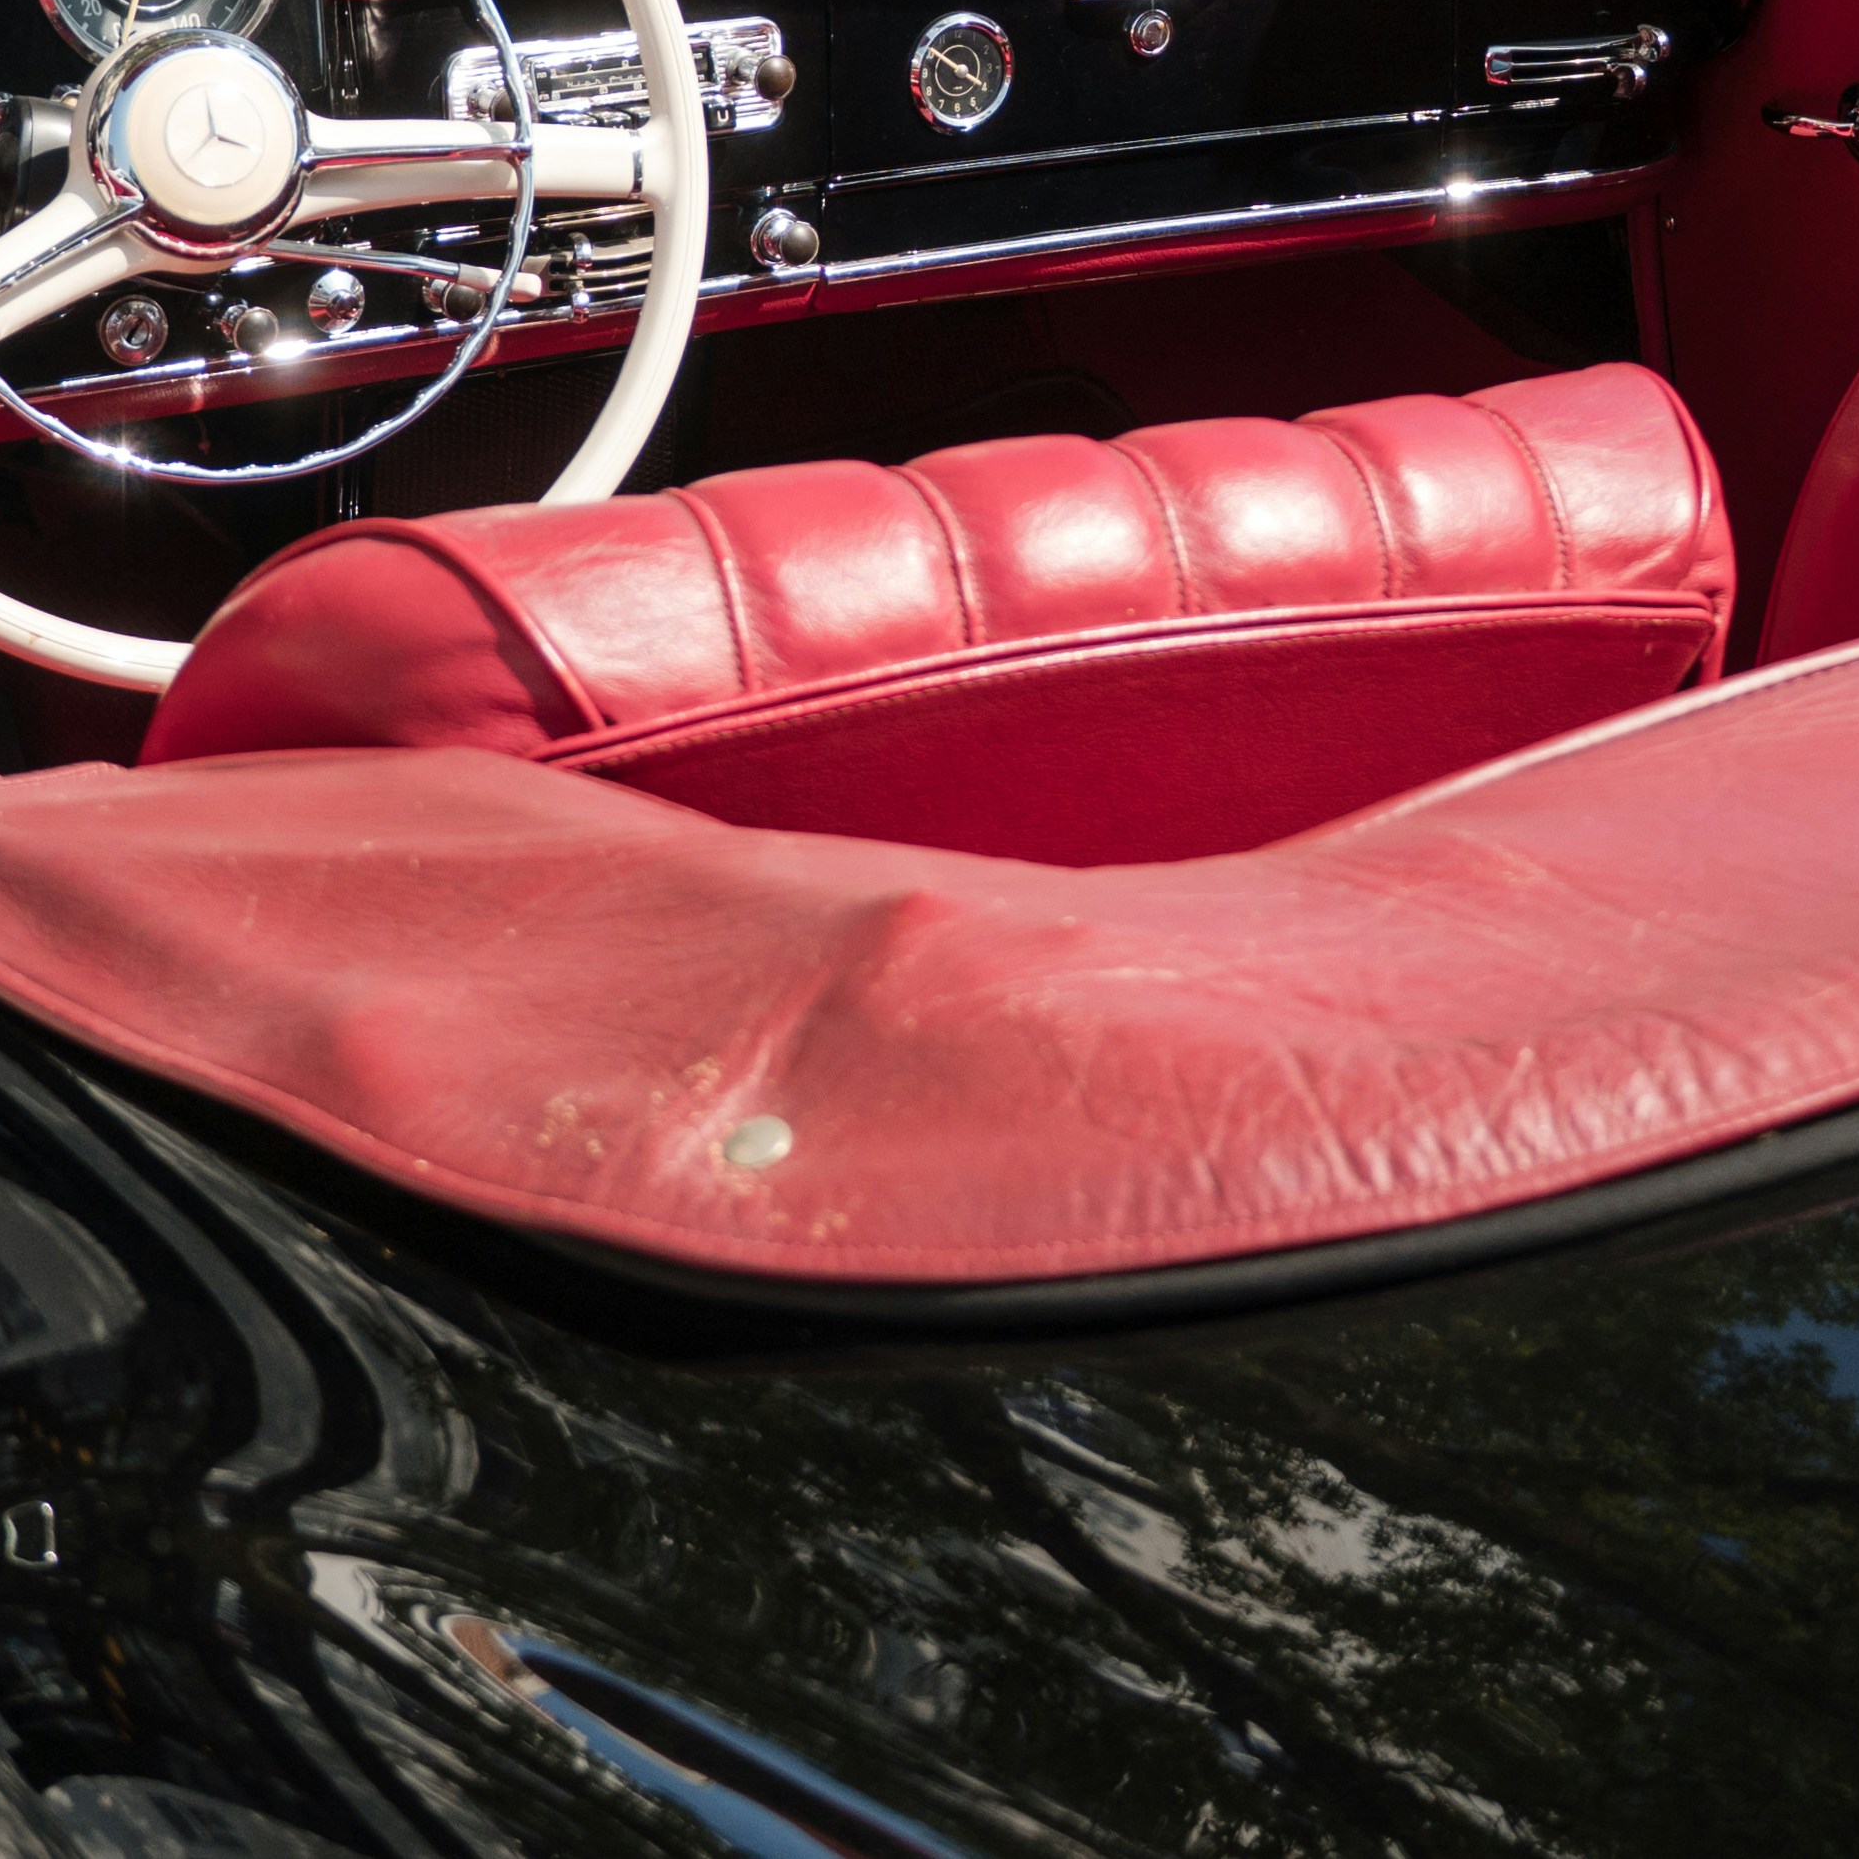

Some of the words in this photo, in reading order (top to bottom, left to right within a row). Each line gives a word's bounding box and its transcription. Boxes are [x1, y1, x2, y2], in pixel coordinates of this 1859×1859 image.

[954, 30, 962, 39] 12
[983, 45, 989, 55] 2
[922, 68, 928, 78] 9
[987, 64, 992, 73] 3
[926, 86, 932, 96] 8
[981, 82, 987, 92] 4
[938, 99, 945, 109] 7
[970, 97, 976, 107] 5
[954, 103, 961, 112] 6
[716, 109, 729, 122] U
